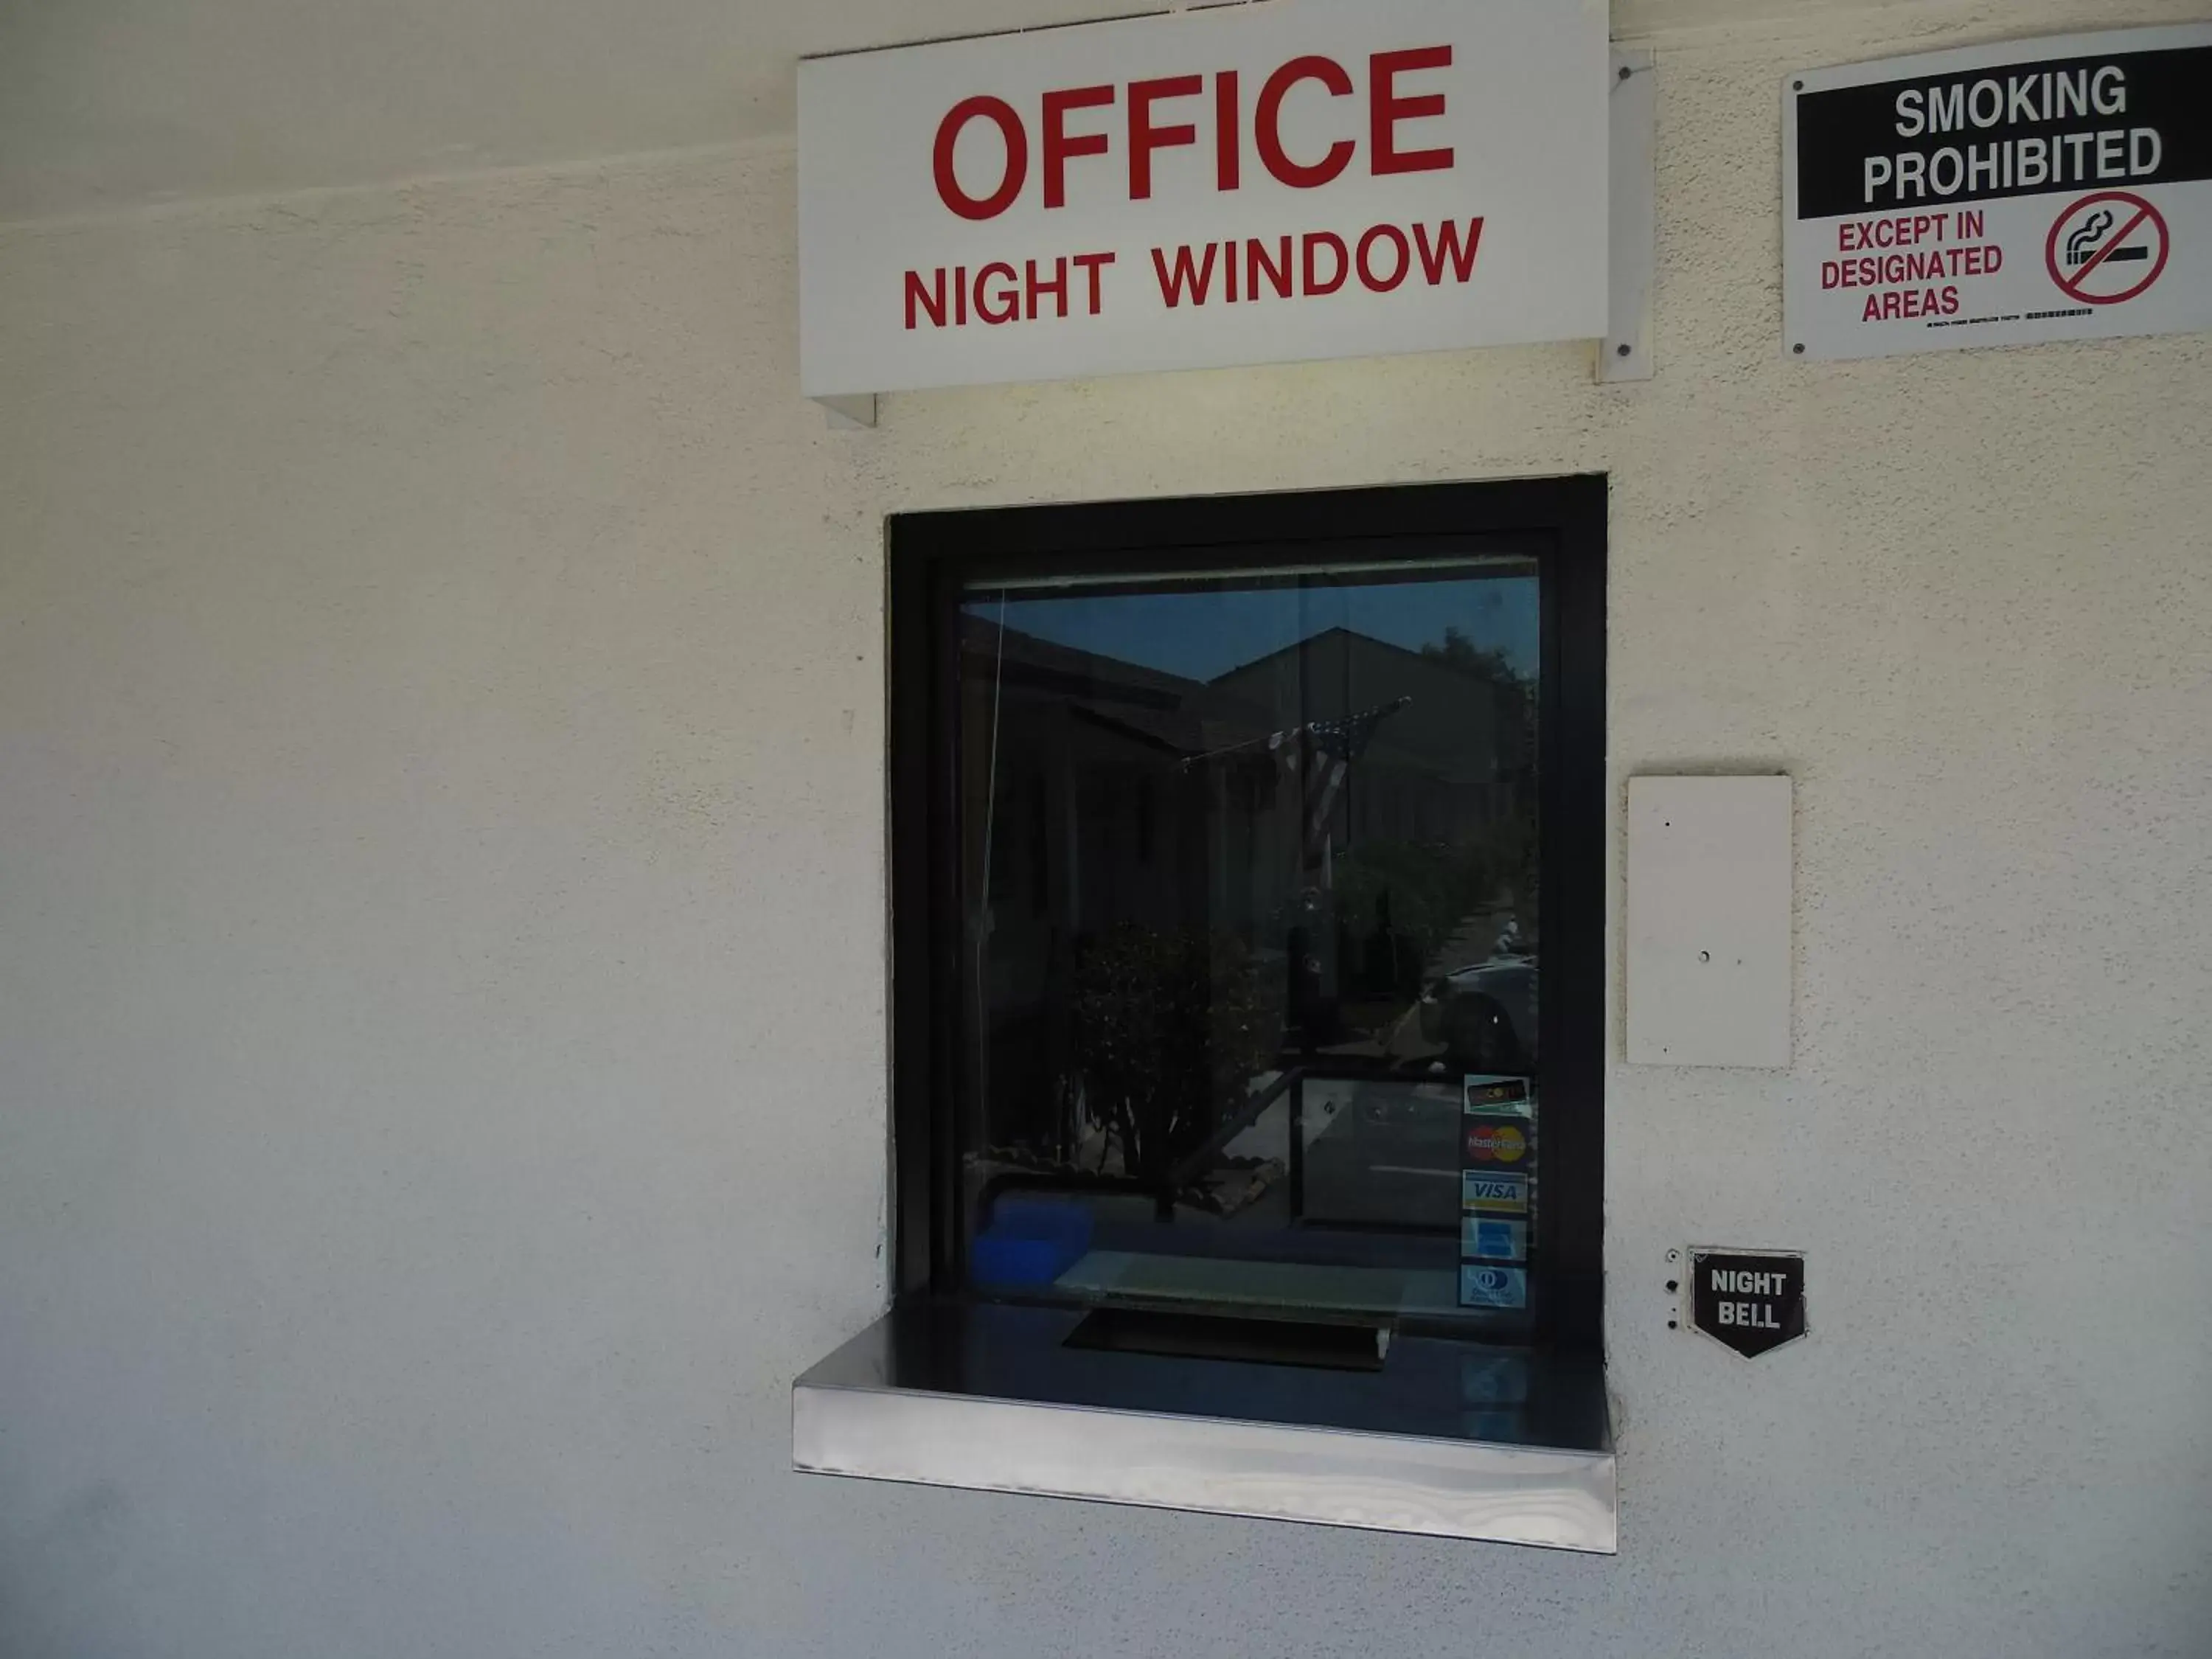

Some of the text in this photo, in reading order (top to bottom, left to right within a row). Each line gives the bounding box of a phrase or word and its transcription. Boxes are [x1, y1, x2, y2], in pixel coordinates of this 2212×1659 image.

[1896, 66, 2126, 138] SMOKING
[933, 45, 1454, 220] OFFICE
[1864, 128, 2163, 204] PROHIBITED
[1840, 211, 1983, 251] EXCEPT IN
[905, 216, 1484, 330] NIGHT WINDOW
[1822, 245, 2003, 289] DESIGNATED
[1863, 285, 1959, 321] AREAS
[1474, 1182, 1517, 1200] VISA
[1711, 1269, 1787, 1295] NIGHT
[1718, 1301, 1781, 1329] BELL
